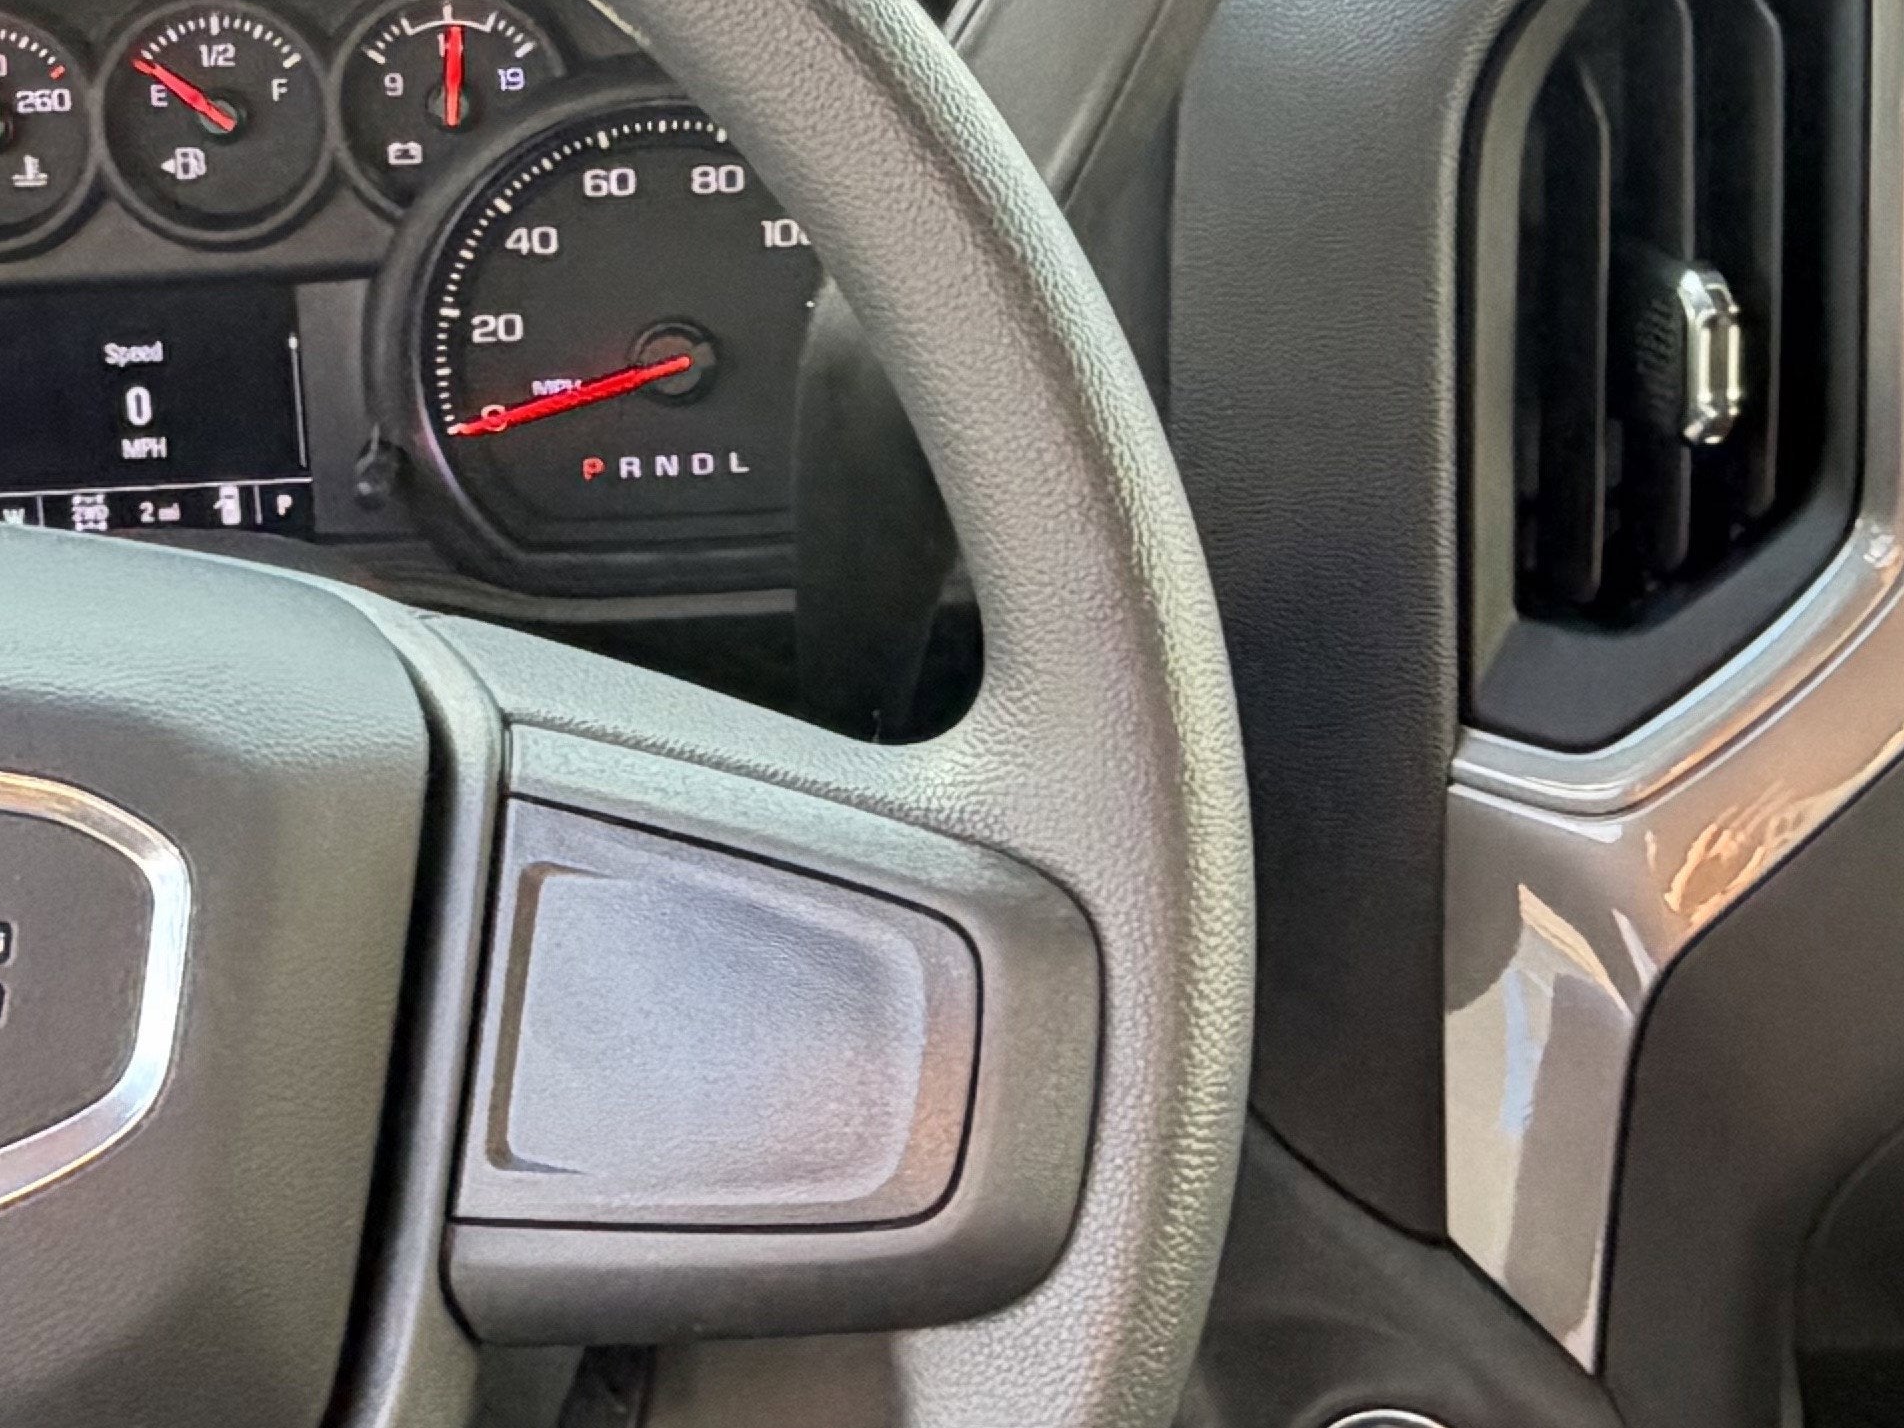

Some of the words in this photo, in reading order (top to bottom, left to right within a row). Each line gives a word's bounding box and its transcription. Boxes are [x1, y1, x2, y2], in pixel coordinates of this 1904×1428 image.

[200, 43, 236, 67] 1/2
[271, 79, 288, 101] F
[384, 73, 405, 98] 9
[497, 67, 526, 91] 19
[16, 90, 72, 113] 260
[151, 85, 169, 108] E
[583, 169, 636, 197] 60
[691, 166, 745, 194] 80
[505, 227, 559, 255] 40
[470, 315, 523, 344] 20
[104, 341, 163, 367] Speed
[125, 386, 153, 427] 0
[121, 438, 167, 460] MPH
[582, 459, 604, 480] P
[619, 456, 642, 479] R
[655, 454, 679, 477] N
[691, 452, 714, 474] D
[729, 452, 749, 473] L
[139, 500, 156, 522] 2
